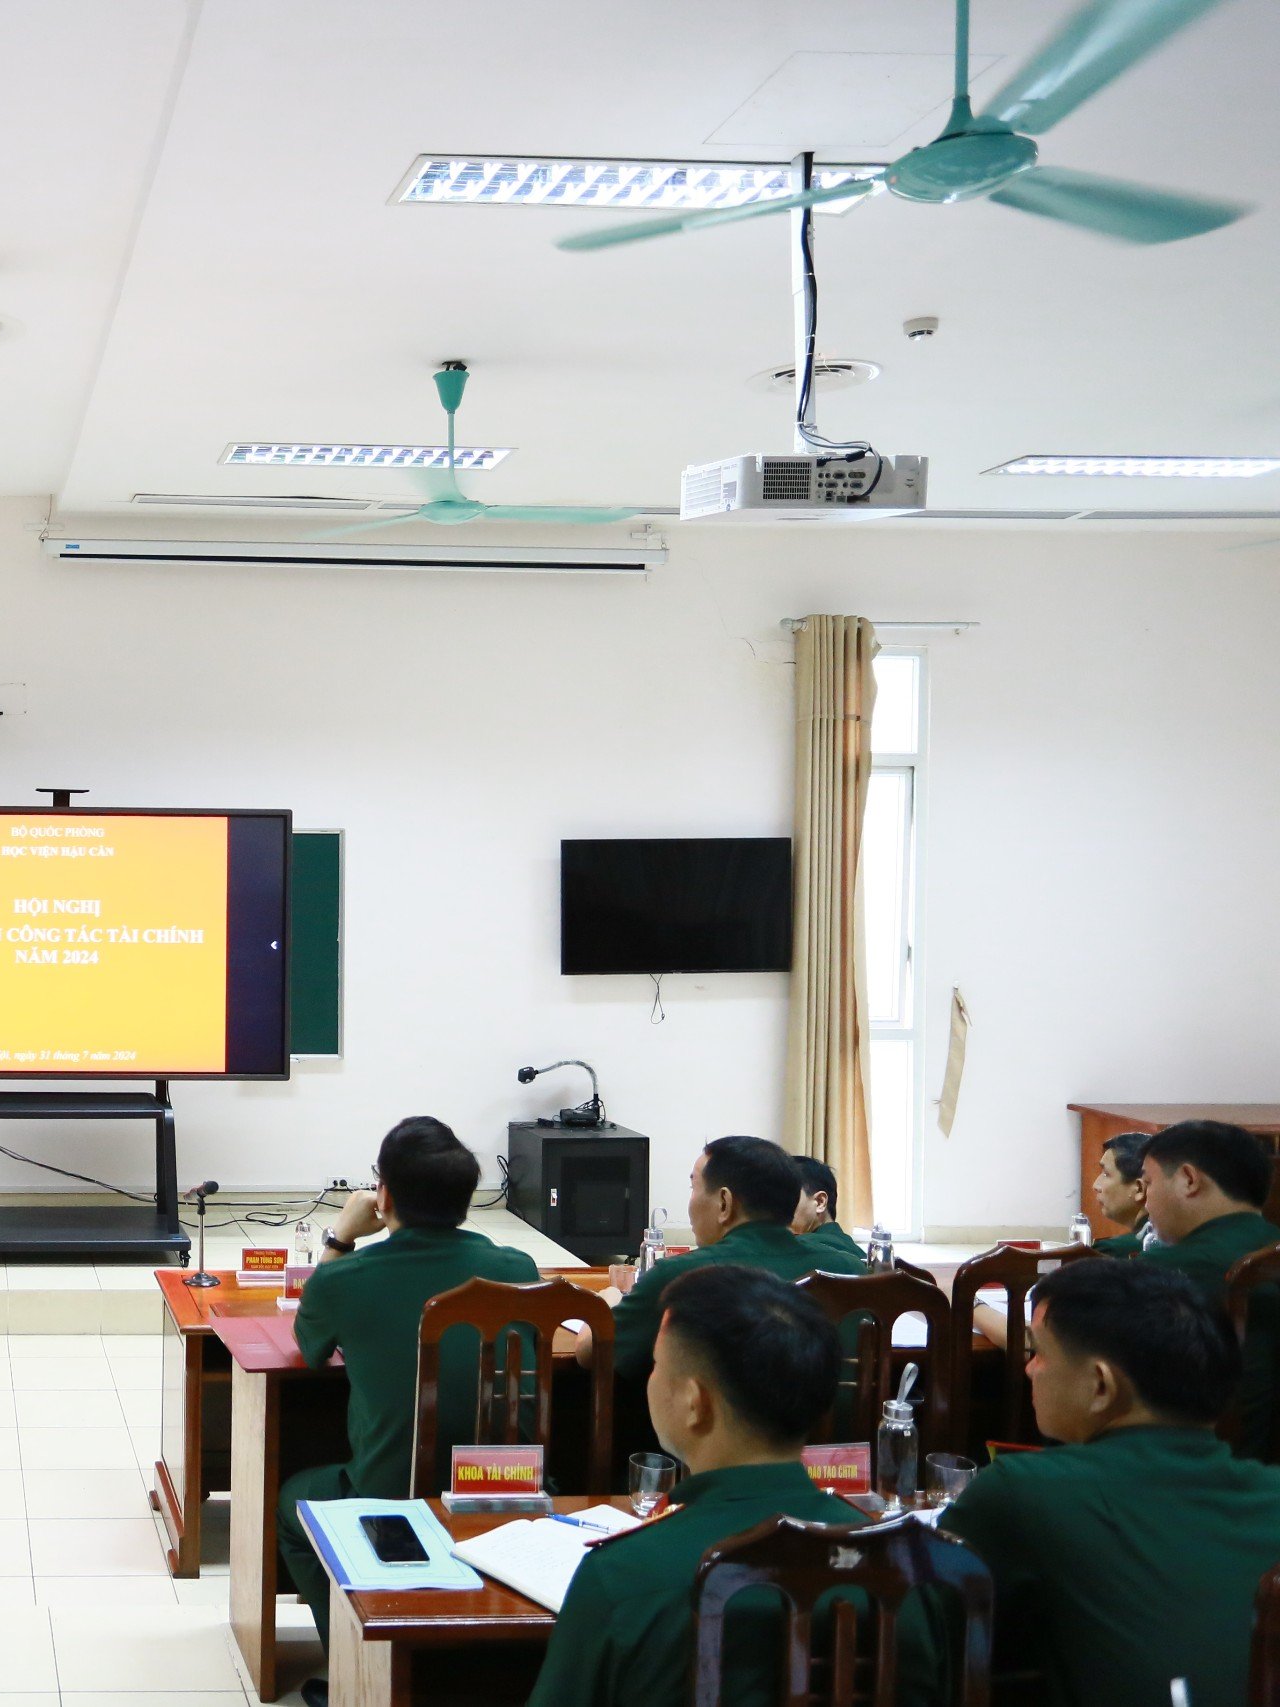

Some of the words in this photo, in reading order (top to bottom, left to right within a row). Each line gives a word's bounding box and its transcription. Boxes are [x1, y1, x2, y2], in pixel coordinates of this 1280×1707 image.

[14, 898, 49, 917] HỘI
[53, 899, 102, 918] NGHỊ
[6, 923, 62, 943] CÔNG
[64, 924, 103, 943] TÁC
[107, 924, 139, 943] TÀI
[142, 925, 204, 944] CHÍNH
[14, 946, 58, 964] NĂM
[62, 949, 100, 965] 2024
[39, 1050, 51, 1060] 31
[83, 1050, 89, 1061] 7
[112, 1050, 136, 1061] 2024
[458, 1466, 484, 1480] KHOA
[487, 1463, 501, 1480] TÀI
[504, 1462, 534, 1480] CHÍNH
